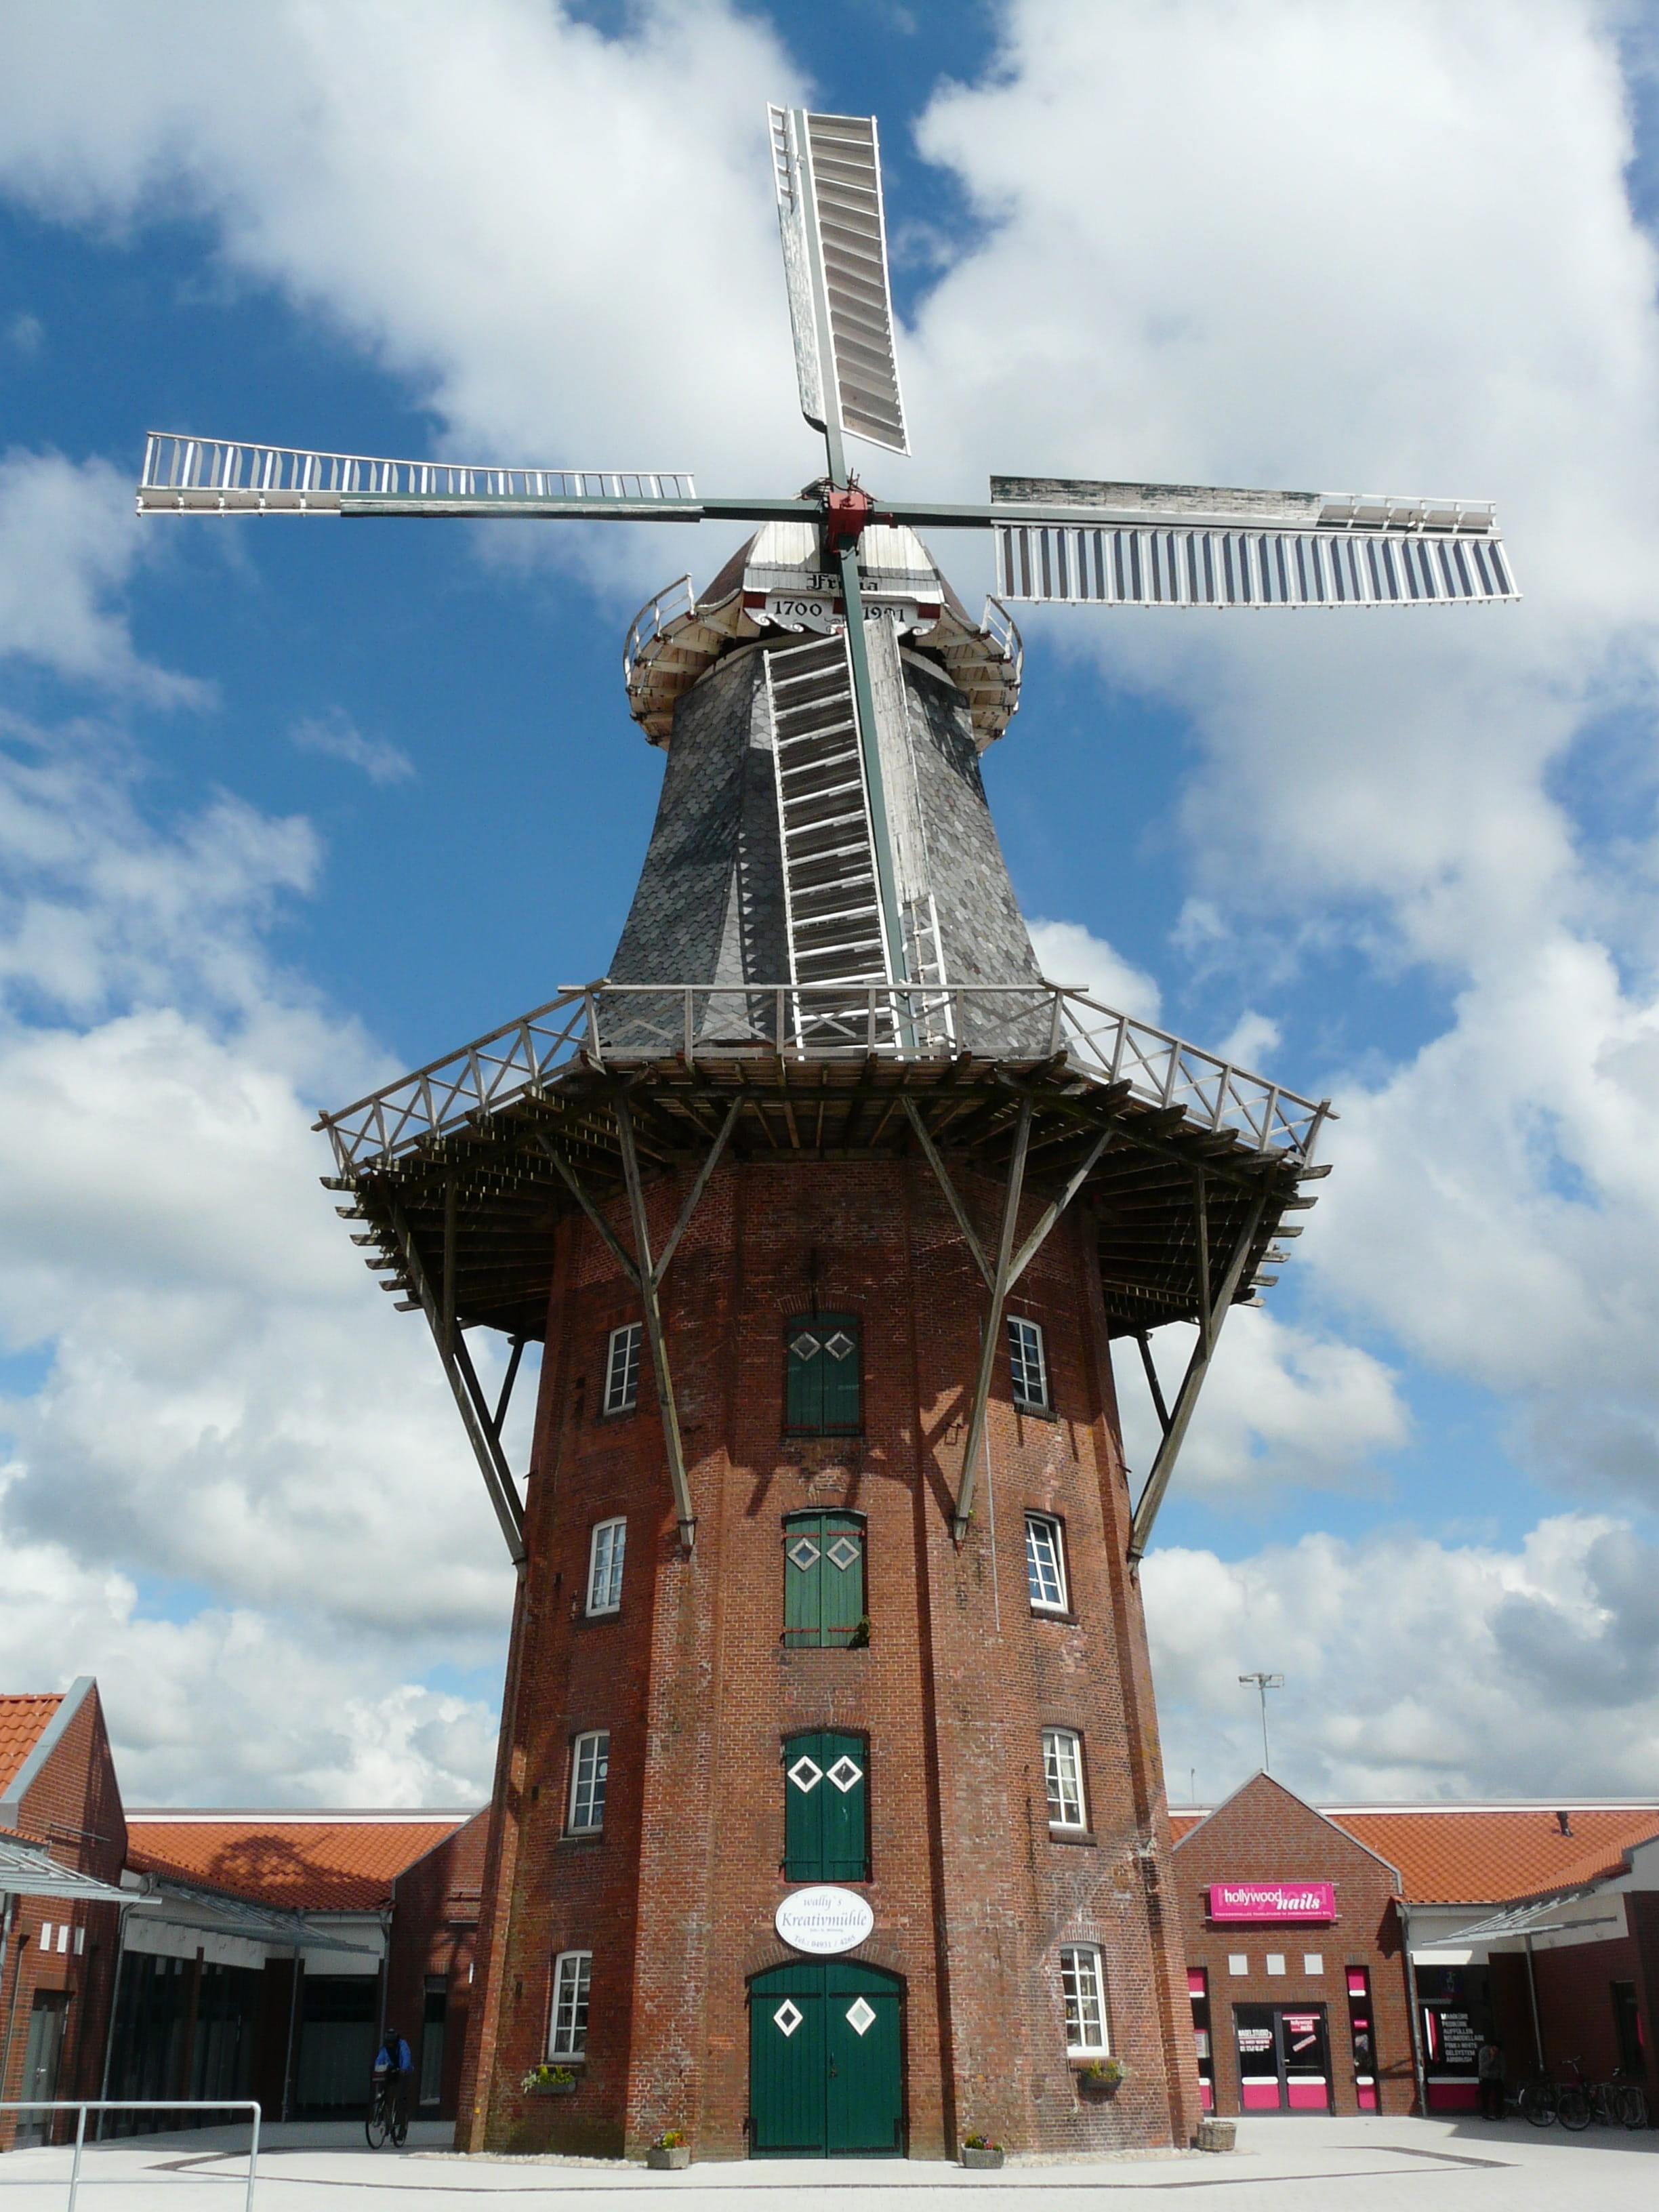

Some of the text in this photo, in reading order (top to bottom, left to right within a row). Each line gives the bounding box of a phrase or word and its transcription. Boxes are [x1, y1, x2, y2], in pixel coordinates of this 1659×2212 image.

[806, 574, 878, 592] Friia
[775, 601, 823, 617] 1700
[1225, 1888, 1282, 1906] hollywood
[1276, 1893, 1320, 1910] nails
[782, 1910, 867, 1926] Kreativmühle
